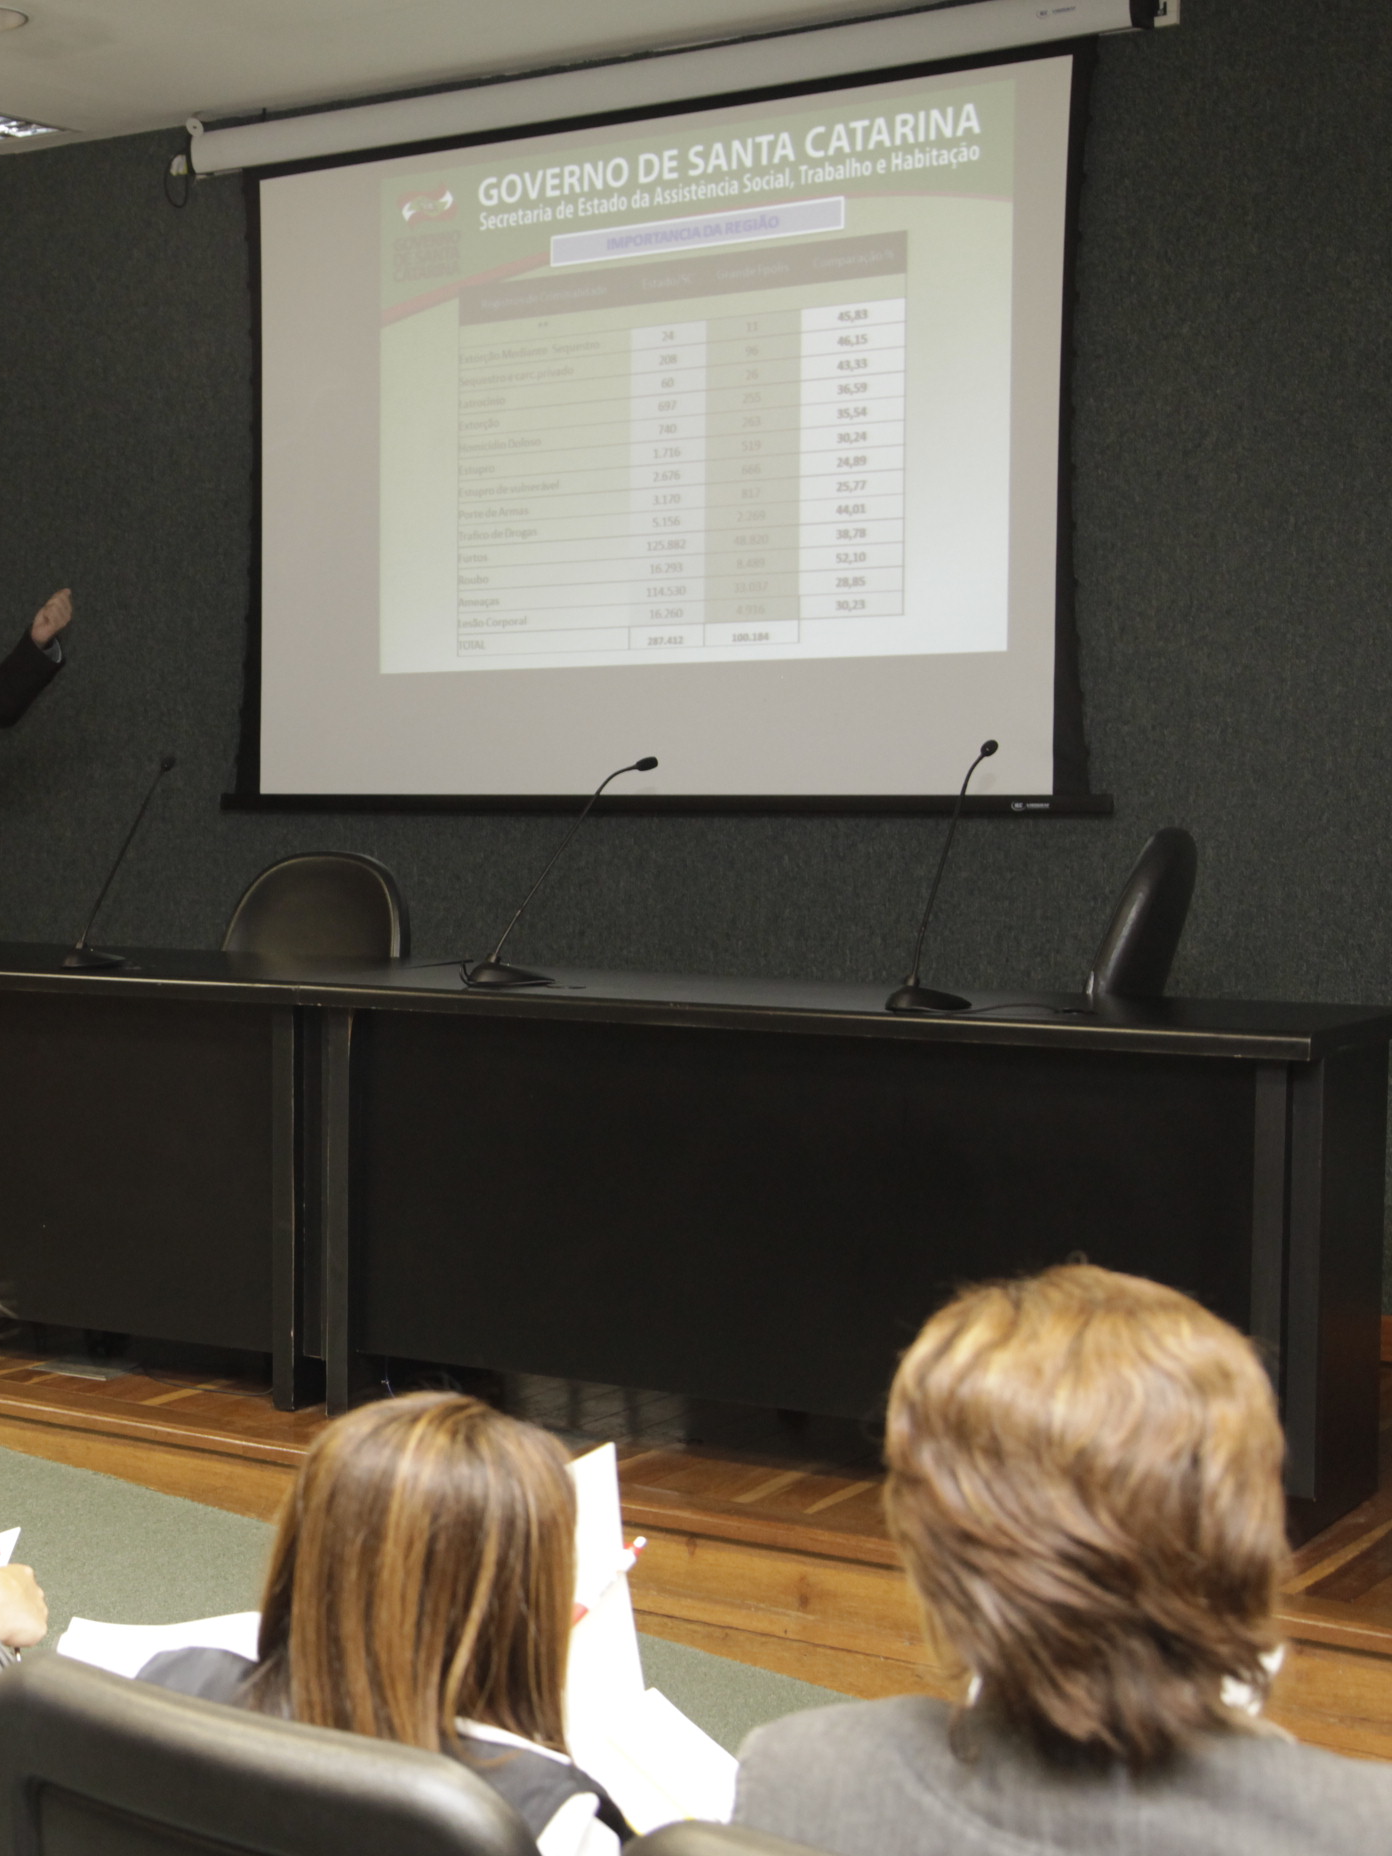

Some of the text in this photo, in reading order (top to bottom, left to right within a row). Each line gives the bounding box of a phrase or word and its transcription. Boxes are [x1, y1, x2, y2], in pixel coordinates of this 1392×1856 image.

[478, 102, 982, 207] GOVERNO DE SANTA CATARINA
[479, 142, 980, 231] Secretaria de Estado da Assistência Social, Trabalho e Habitação
[607, 214, 779, 250] IMPORTANCIA DA REGIÃO
[662, 330, 675, 342] 24
[837, 308, 868, 323] 45,83
[658, 354, 677, 366] 208
[837, 333, 868, 347] 46,15
[661, 377, 675, 389] 60
[837, 358, 868, 372] 43,33
[658, 400, 677, 412] 697
[837, 382, 868, 396] 36,59
[658, 423, 677, 435] 740
[837, 406, 868, 420] 35,54
[653, 447, 681, 460] 1.716
[837, 430, 868, 445] 30,24
[653, 470, 681, 482] 2.676
[835, 455, 867, 469] 24,89
[652, 493, 681, 506] 3.170
[835, 479, 867, 493] 25,77
[652, 516, 681, 528] 5.156
[835, 503, 867, 516] 44,01
[646, 538, 686, 552] 125.882
[835, 527, 867, 540] 38,78
[458, 574, 489, 585] Roubo
[650, 561, 683, 575] 16.293
[835, 551, 867, 564] 52,10
[646, 585, 686, 599] 114.530
[835, 575, 867, 589] 28,85
[486, 616, 527, 628] Corporal
[649, 607, 684, 620] 16.260
[835, 598, 867, 612] 30,23
[647, 634, 685, 647] 287.412
[731, 631, 770, 643] 100.184
